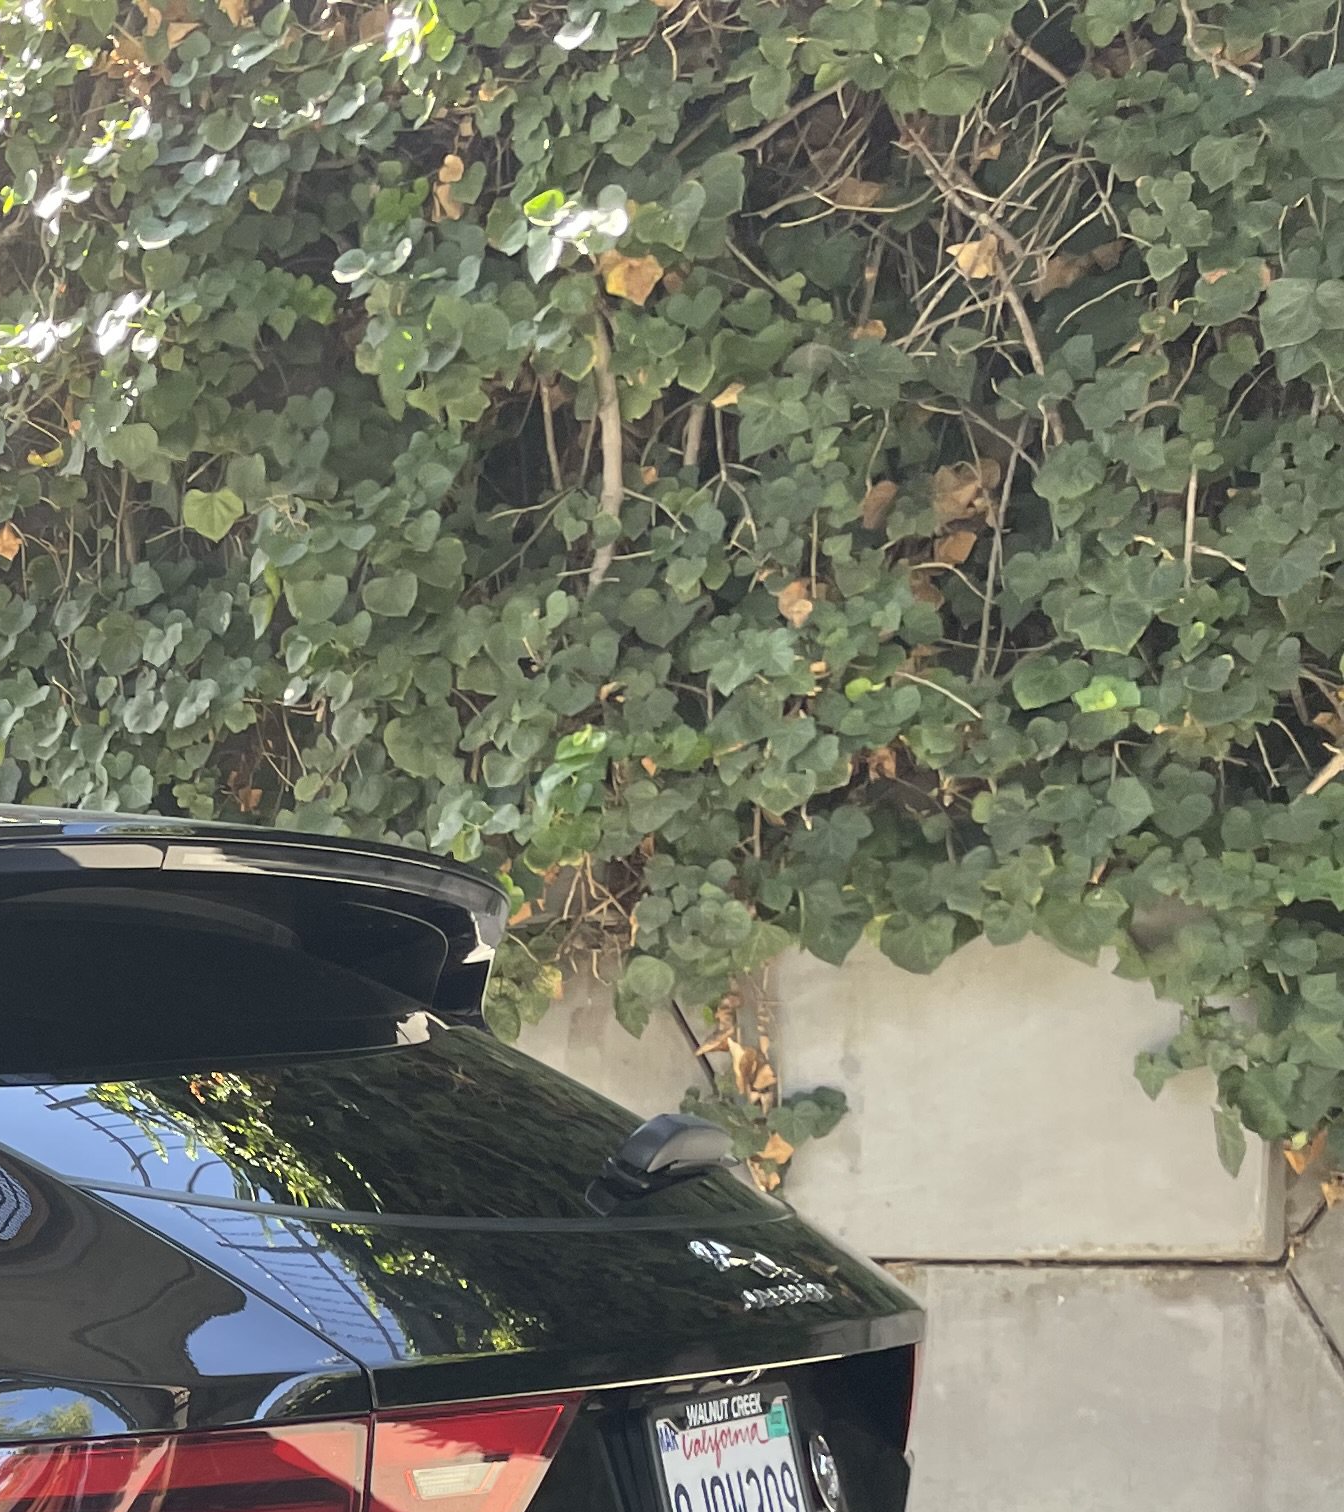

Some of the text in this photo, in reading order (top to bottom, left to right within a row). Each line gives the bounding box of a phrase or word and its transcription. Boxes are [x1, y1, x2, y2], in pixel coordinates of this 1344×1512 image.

[686, 1392, 762, 1426] WALNUT CREEK
[682, 1422, 769, 1468] California
